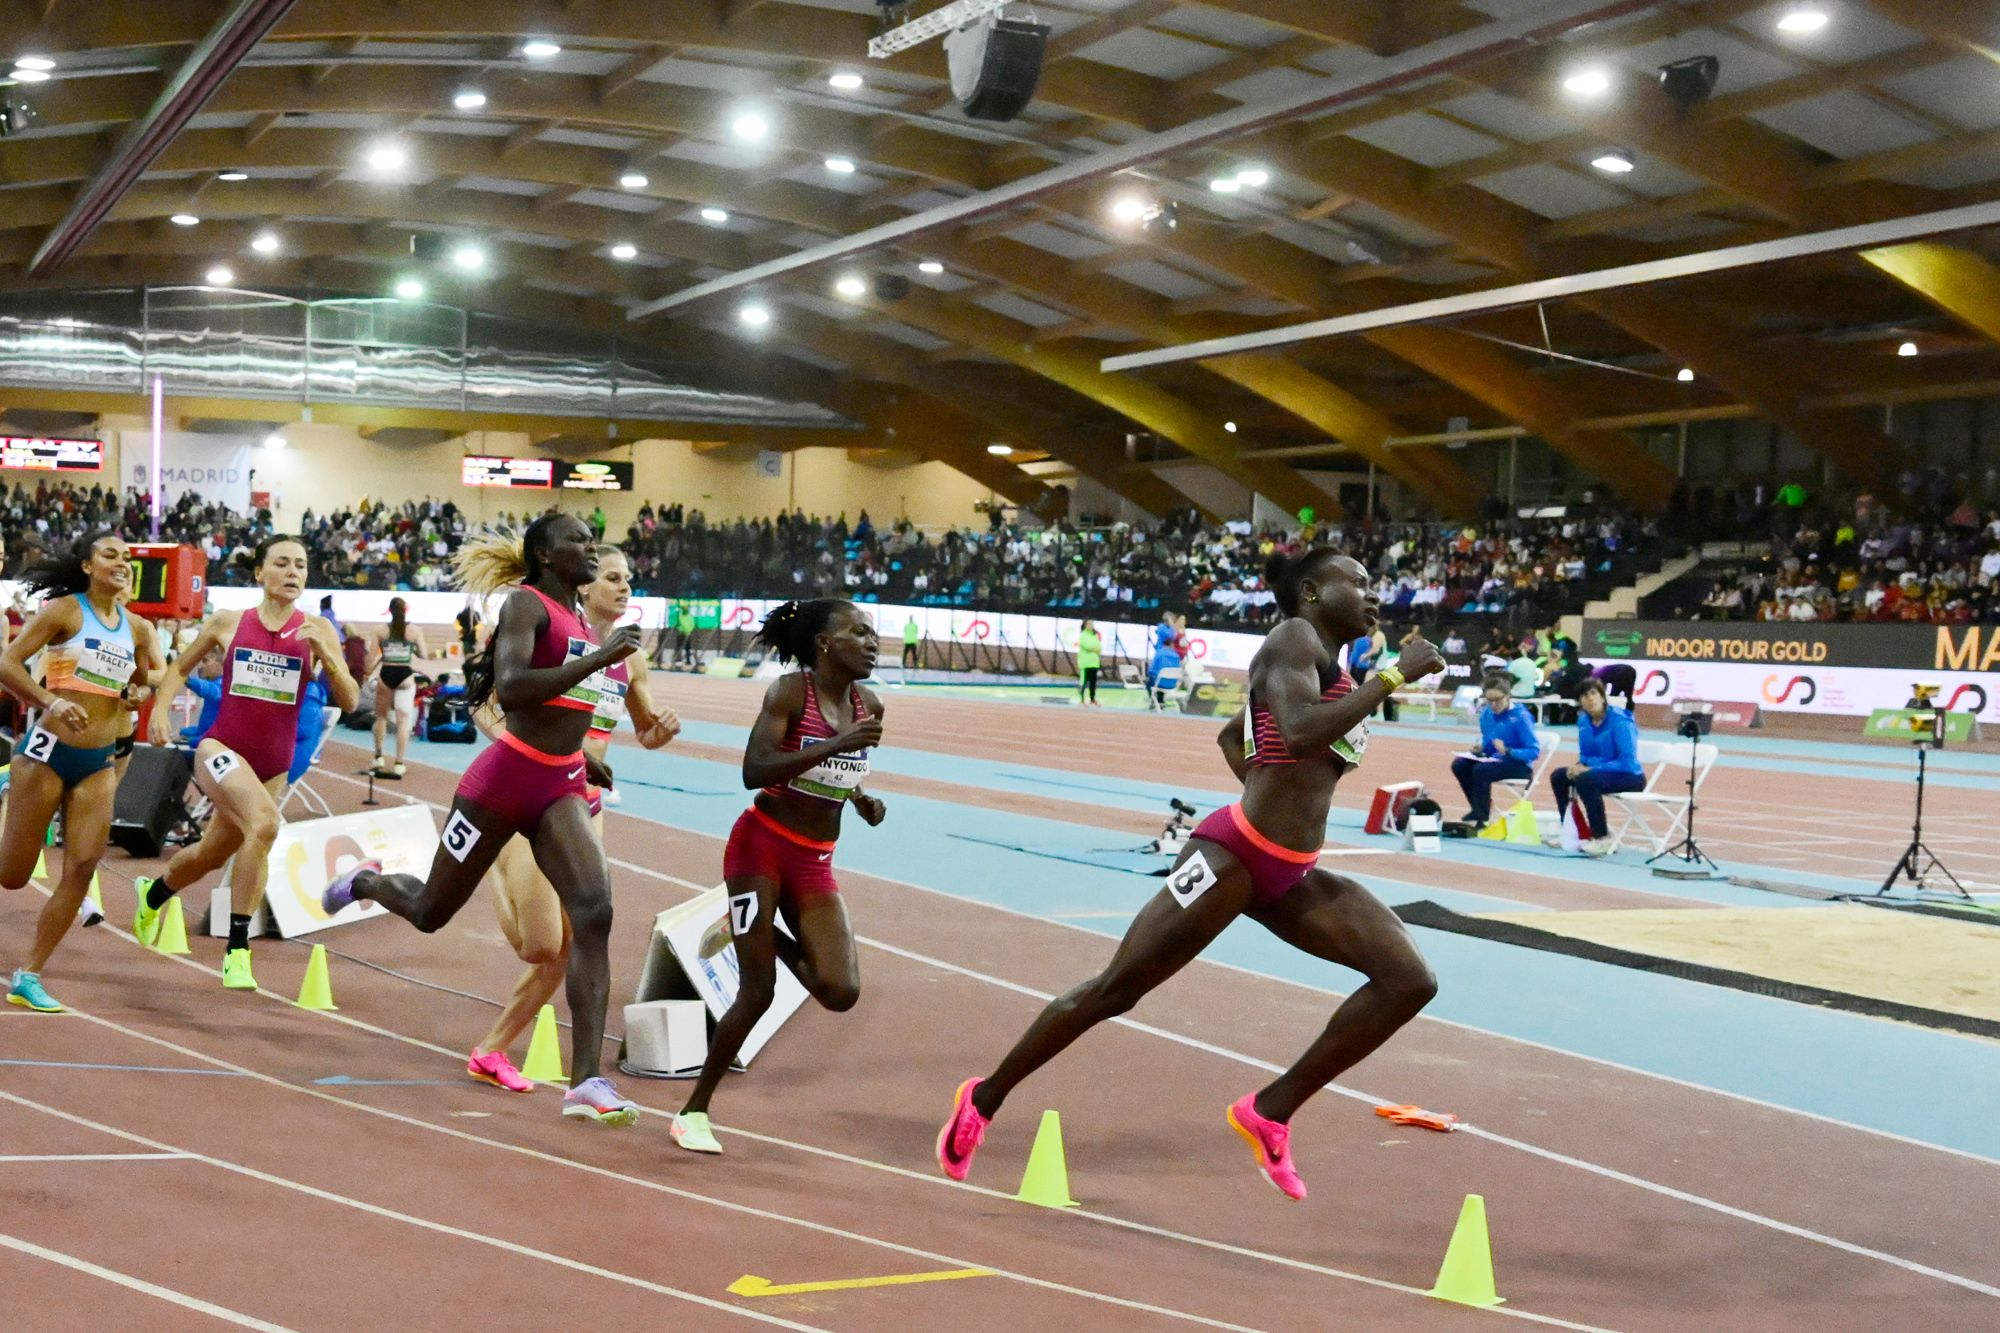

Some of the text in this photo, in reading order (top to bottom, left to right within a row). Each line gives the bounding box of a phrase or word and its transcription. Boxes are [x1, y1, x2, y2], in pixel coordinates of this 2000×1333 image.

[160, 467, 240, 483] MADRID
[1646, 638, 1715, 658] INDOOR
[1719, 639, 1768, 660] TOUR
[1772, 641, 1827, 661] GOLD
[246, 664, 288, 678] BISSET
[29, 732, 50, 758] 2
[448, 819, 473, 850] 5
[1173, 862, 1205, 895] 8
[733, 897, 751, 929] 7
